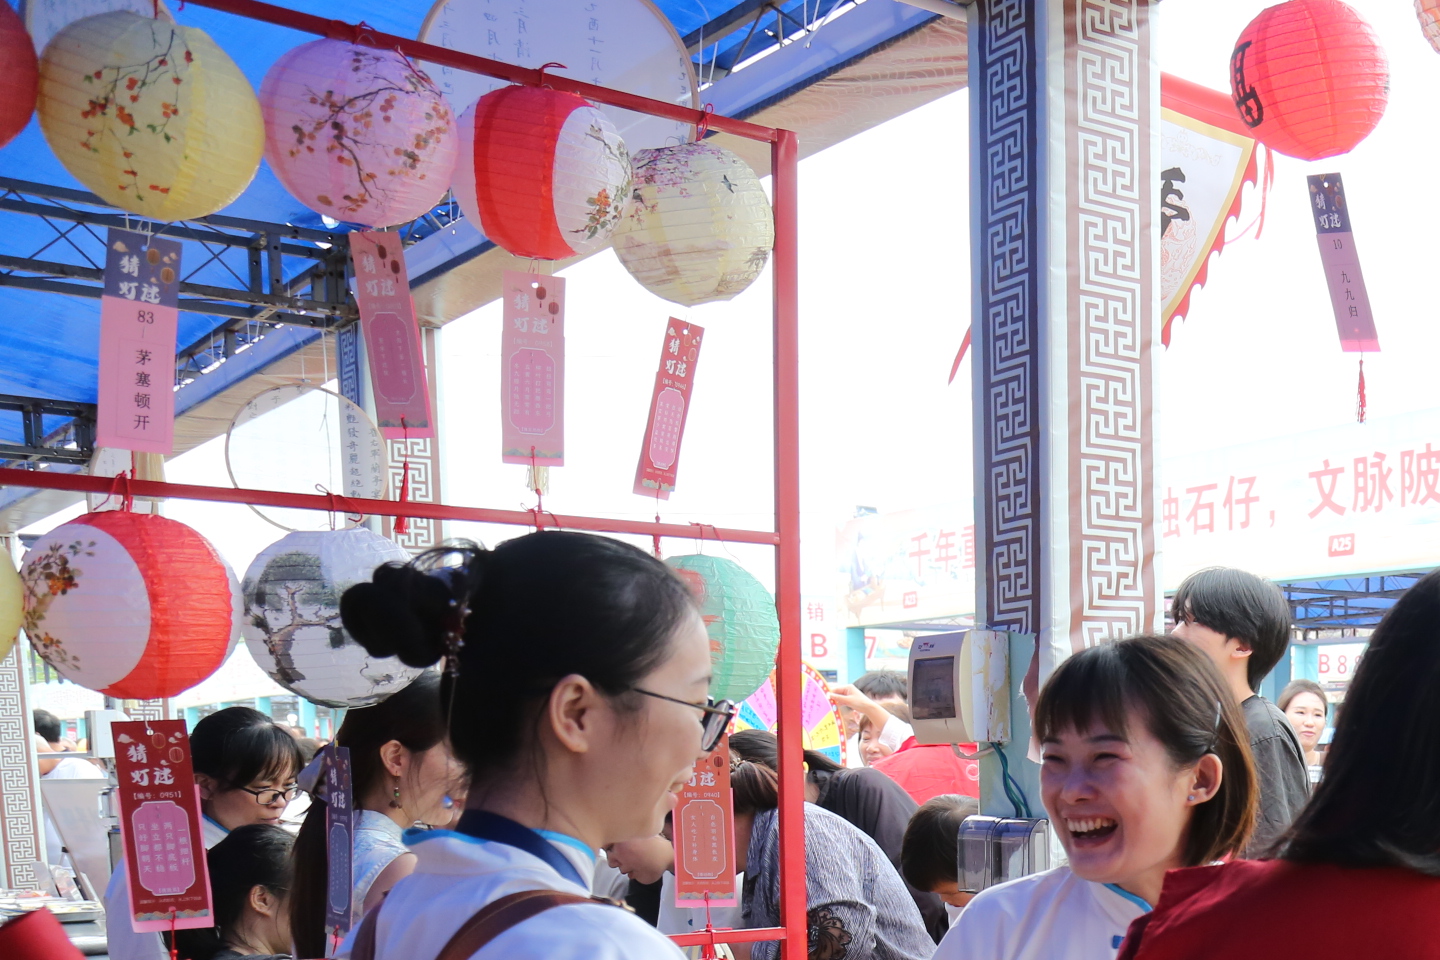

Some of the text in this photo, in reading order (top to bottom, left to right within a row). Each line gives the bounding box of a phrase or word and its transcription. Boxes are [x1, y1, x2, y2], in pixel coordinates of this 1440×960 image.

[1315, 193, 1327, 210] 猜
[1333, 239, 1343, 250] 10
[119, 255, 140, 277] 猜
[1341, 271, 1359, 318] 九九归
[137, 310, 154, 324] 83
[134, 349, 152, 431] 茅塞顿开
[1331, 537, 1352, 552] A25
[127, 743, 147, 763] 猜
[131, 767, 174, 786] 灯谜
